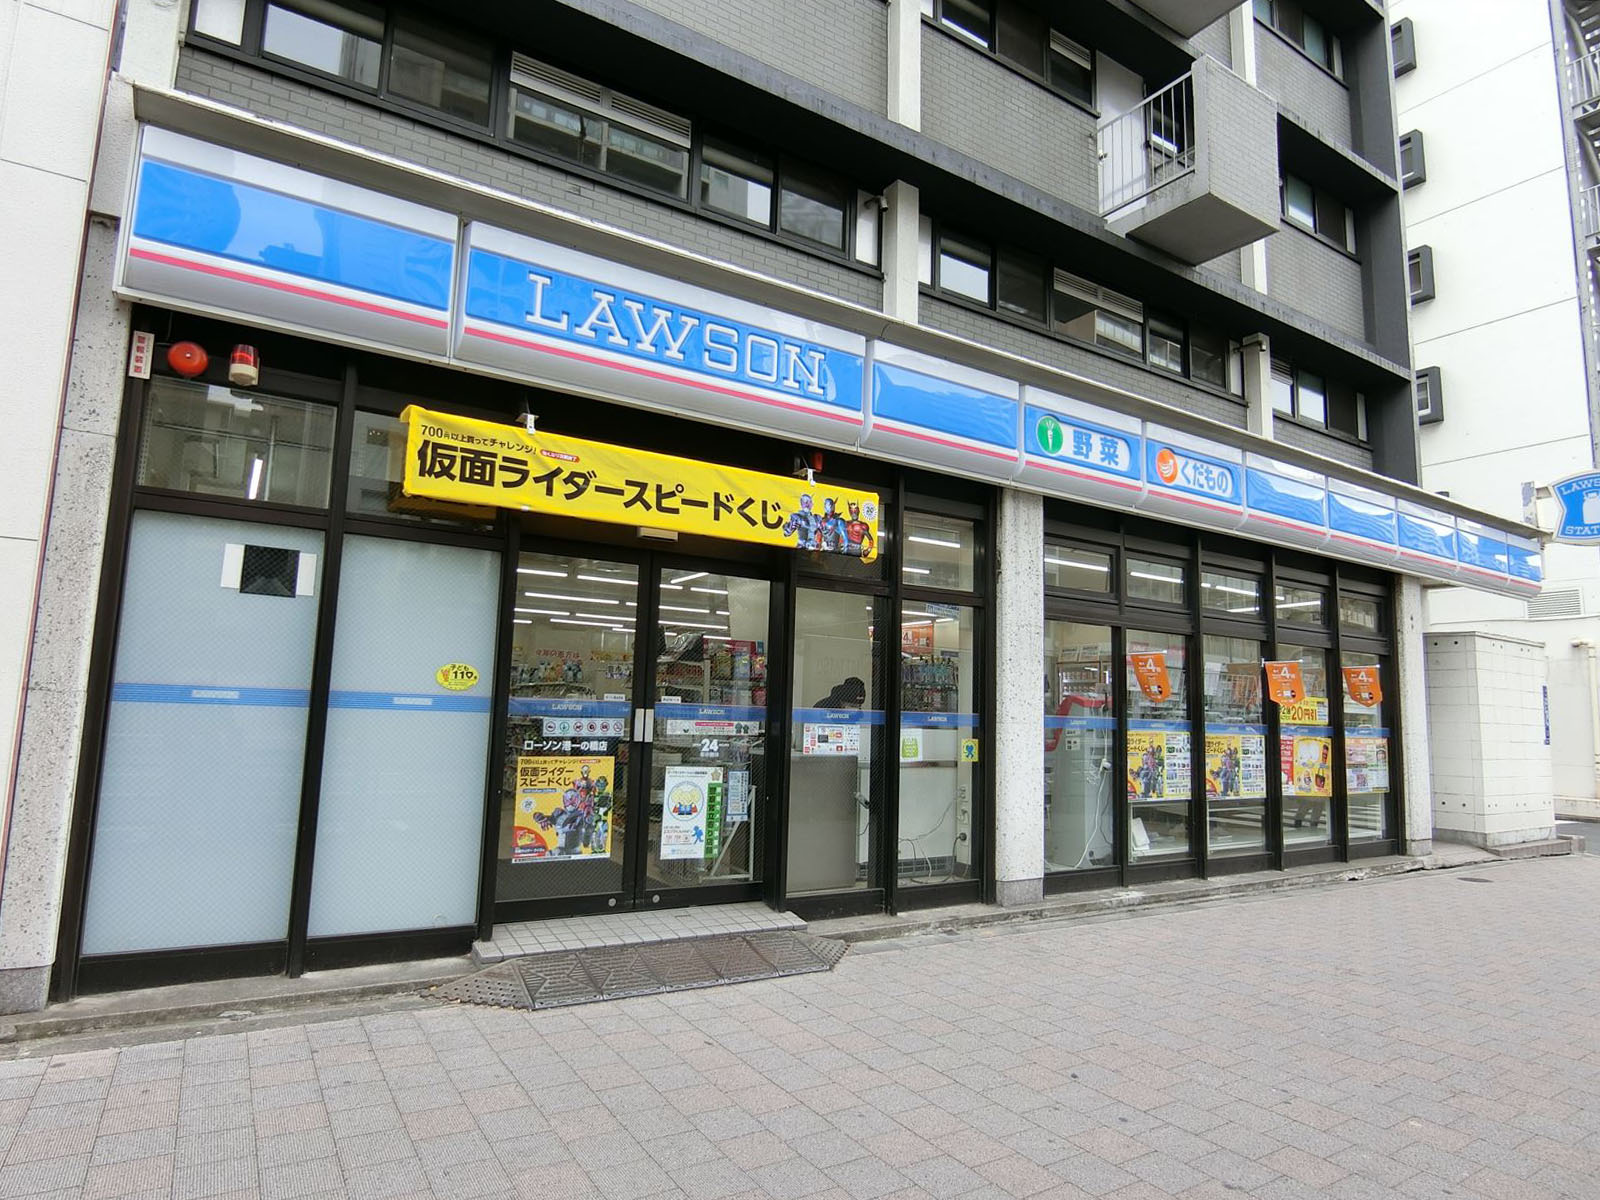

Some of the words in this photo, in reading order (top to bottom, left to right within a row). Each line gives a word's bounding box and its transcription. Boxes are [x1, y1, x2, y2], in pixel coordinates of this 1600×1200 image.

[525, 272, 825, 396] LAWSON
[1072, 428, 1119, 466] 野菜
[417, 439, 784, 530] 仮面ライダースピードくじ
[1180, 459, 1229, 494] くだもの
[523, 740, 608, 752] ローソン港一の橋店
[701, 738, 719, 752] 24
[519, 776, 571, 787] スピードくじ
[520, 766, 574, 777] 仮面ライダー
